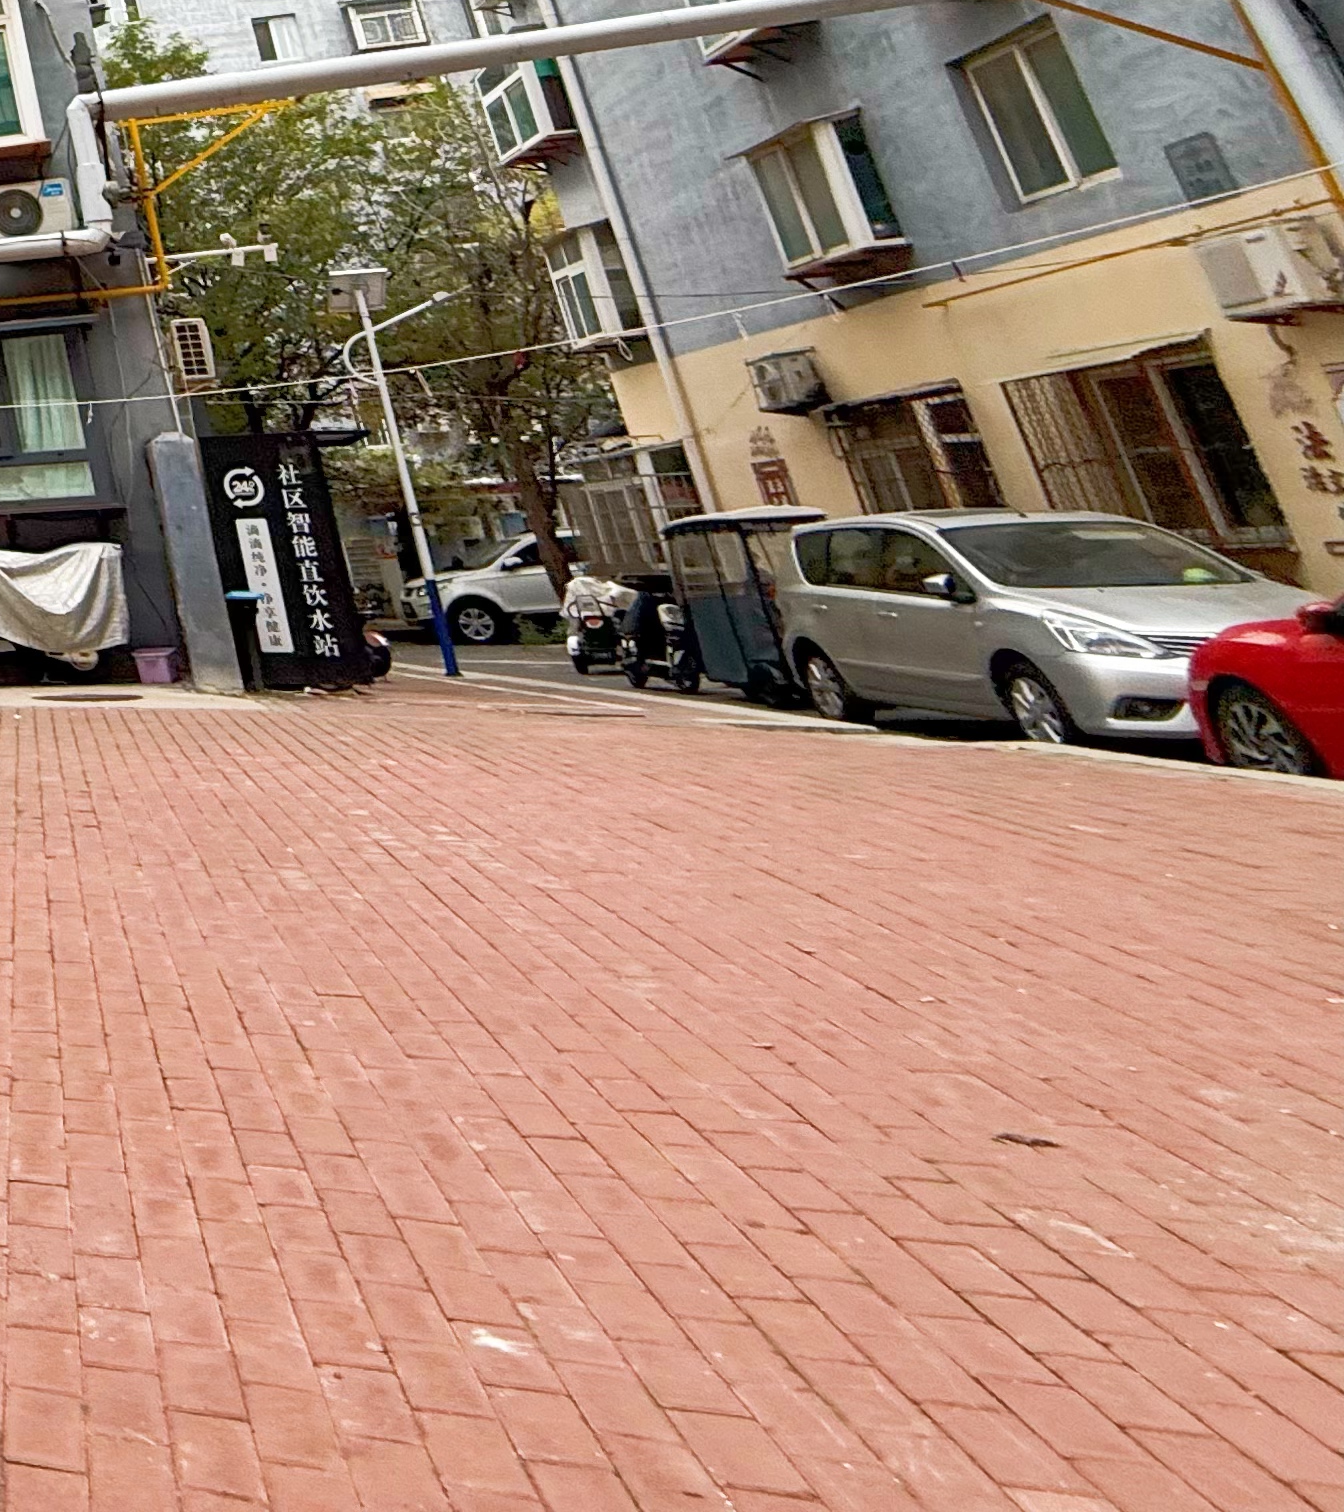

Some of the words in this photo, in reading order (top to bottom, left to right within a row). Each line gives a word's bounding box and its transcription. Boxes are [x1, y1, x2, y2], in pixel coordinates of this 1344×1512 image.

[276, 463, 340, 658] 社区智能直饮水站
